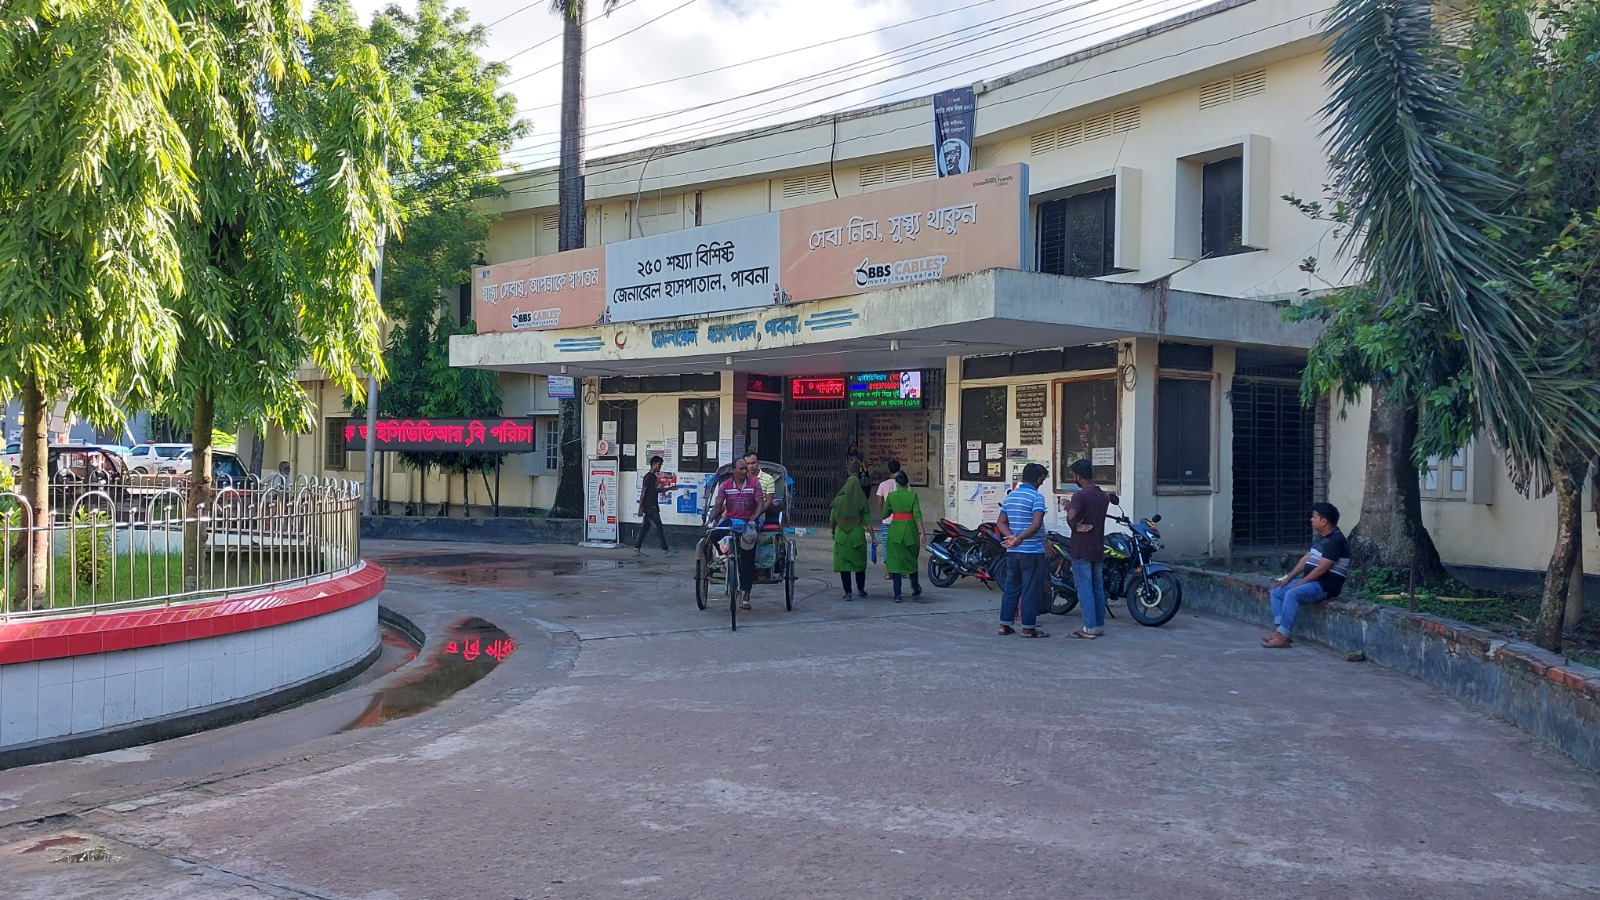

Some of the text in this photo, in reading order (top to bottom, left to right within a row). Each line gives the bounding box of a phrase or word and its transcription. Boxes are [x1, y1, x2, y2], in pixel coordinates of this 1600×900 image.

[809, 226, 844, 250] সেবা
[847, 216, 884, 244] নিন,
[927, 202, 978, 235] থাকুন
[637, 241, 735, 277] ২৫০ শয্যা বিশিষ্ট
[868, 265, 891, 279] BBS
[481, 268, 600, 305] স্বাস্থ্য সেবায়, আপনাকে স্বাগতম
[613, 266, 770, 304] জেনারেল হাসপাতাল, পাবনা
[518, 313, 531, 322] BBS
[651, 328, 698, 349] জেনারেল
[490, 419, 533, 444] পরিচা
